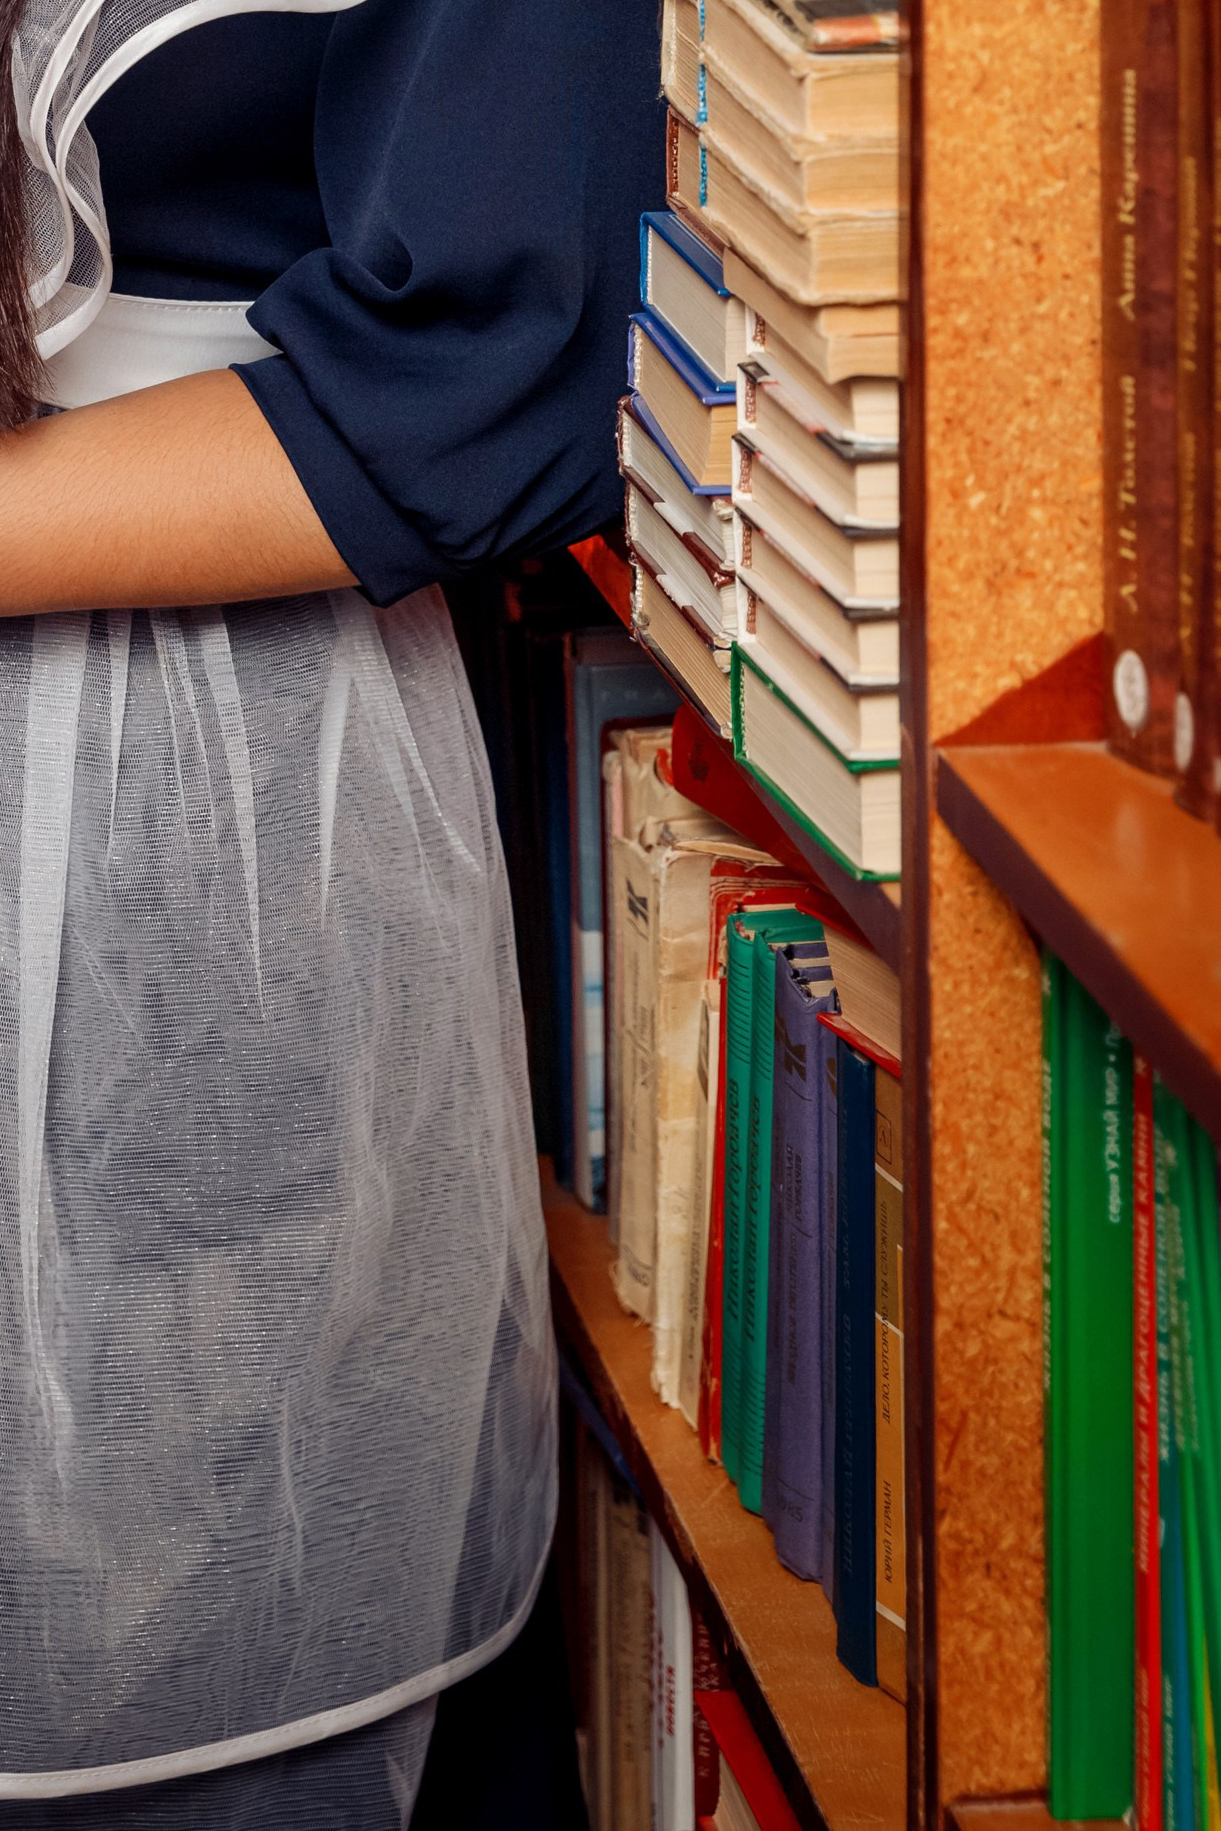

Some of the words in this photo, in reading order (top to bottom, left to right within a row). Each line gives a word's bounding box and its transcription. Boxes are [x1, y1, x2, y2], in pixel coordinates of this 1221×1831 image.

[1117, 235, 1136, 321] Анна
[1104, 1067, 1120, 1105] МИР
[1101, 1110, 1121, 1172] УЗНАЙ
[1136, 1114, 1148, 1205] КАМНИ
[879, 1201, 889, 1276] СЛУЖИШЬ
[880, 1306, 890, 1380] КОТОРОМУ
[881, 1382, 892, 1425] ДЕЛО,
[882, 1481, 892, 1537] ГЕРМАН
[882, 1539, 892, 1583] ЮРИЙ
